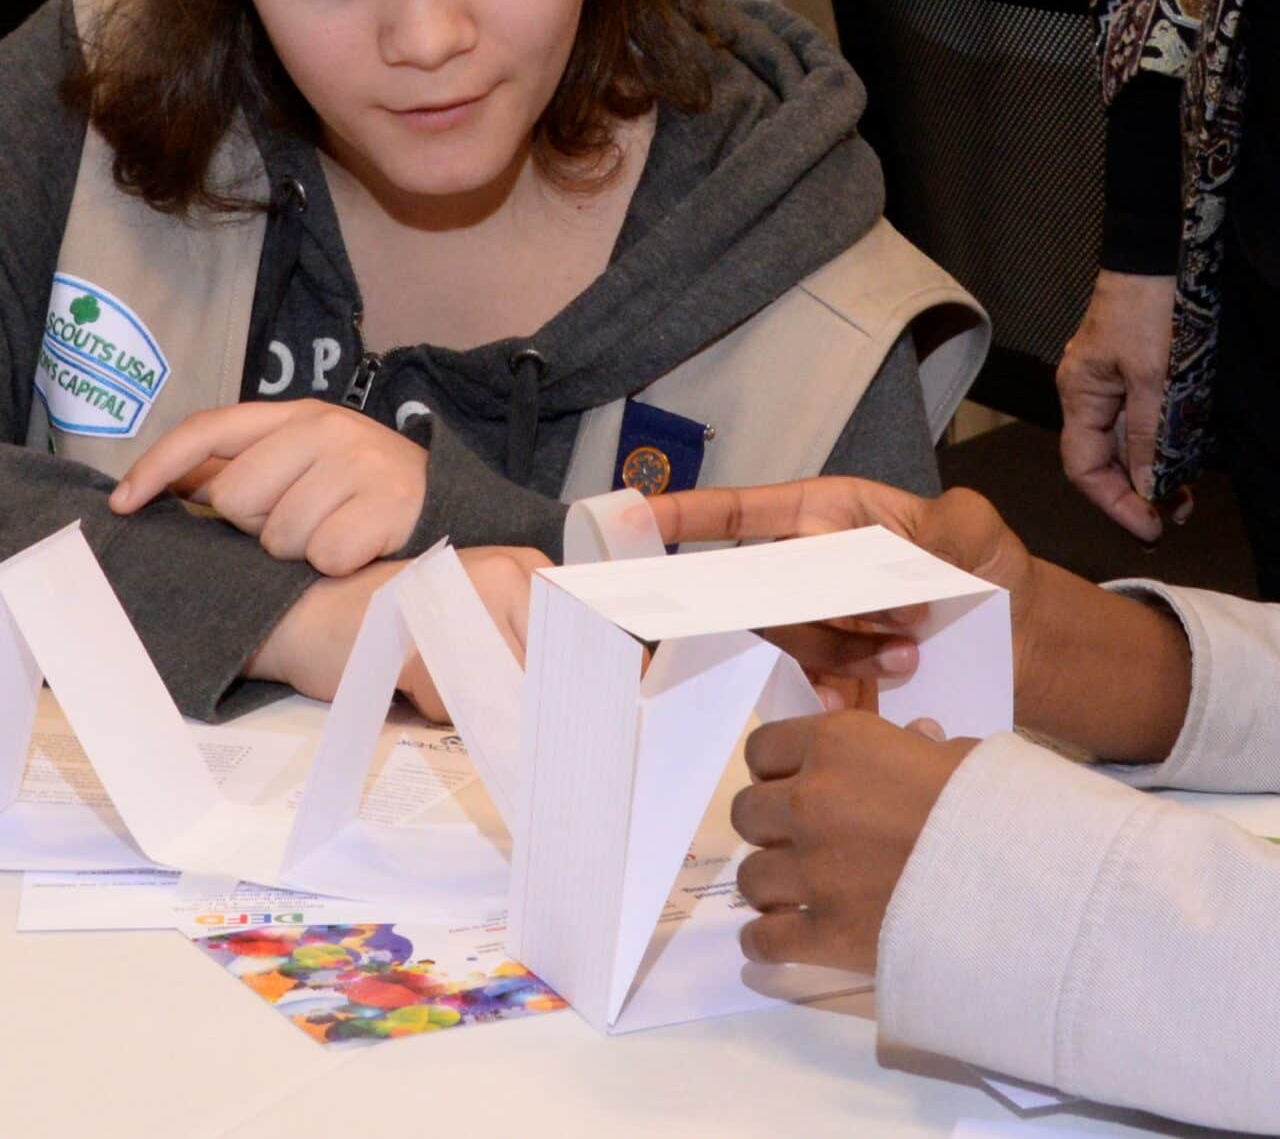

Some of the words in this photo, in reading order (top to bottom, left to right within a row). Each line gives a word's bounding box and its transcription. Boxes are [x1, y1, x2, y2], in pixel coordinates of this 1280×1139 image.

[46, 311, 118, 362] SCOUTS
[115, 350, 156, 390] USA
[58, 368, 127, 422] CAPITAL
